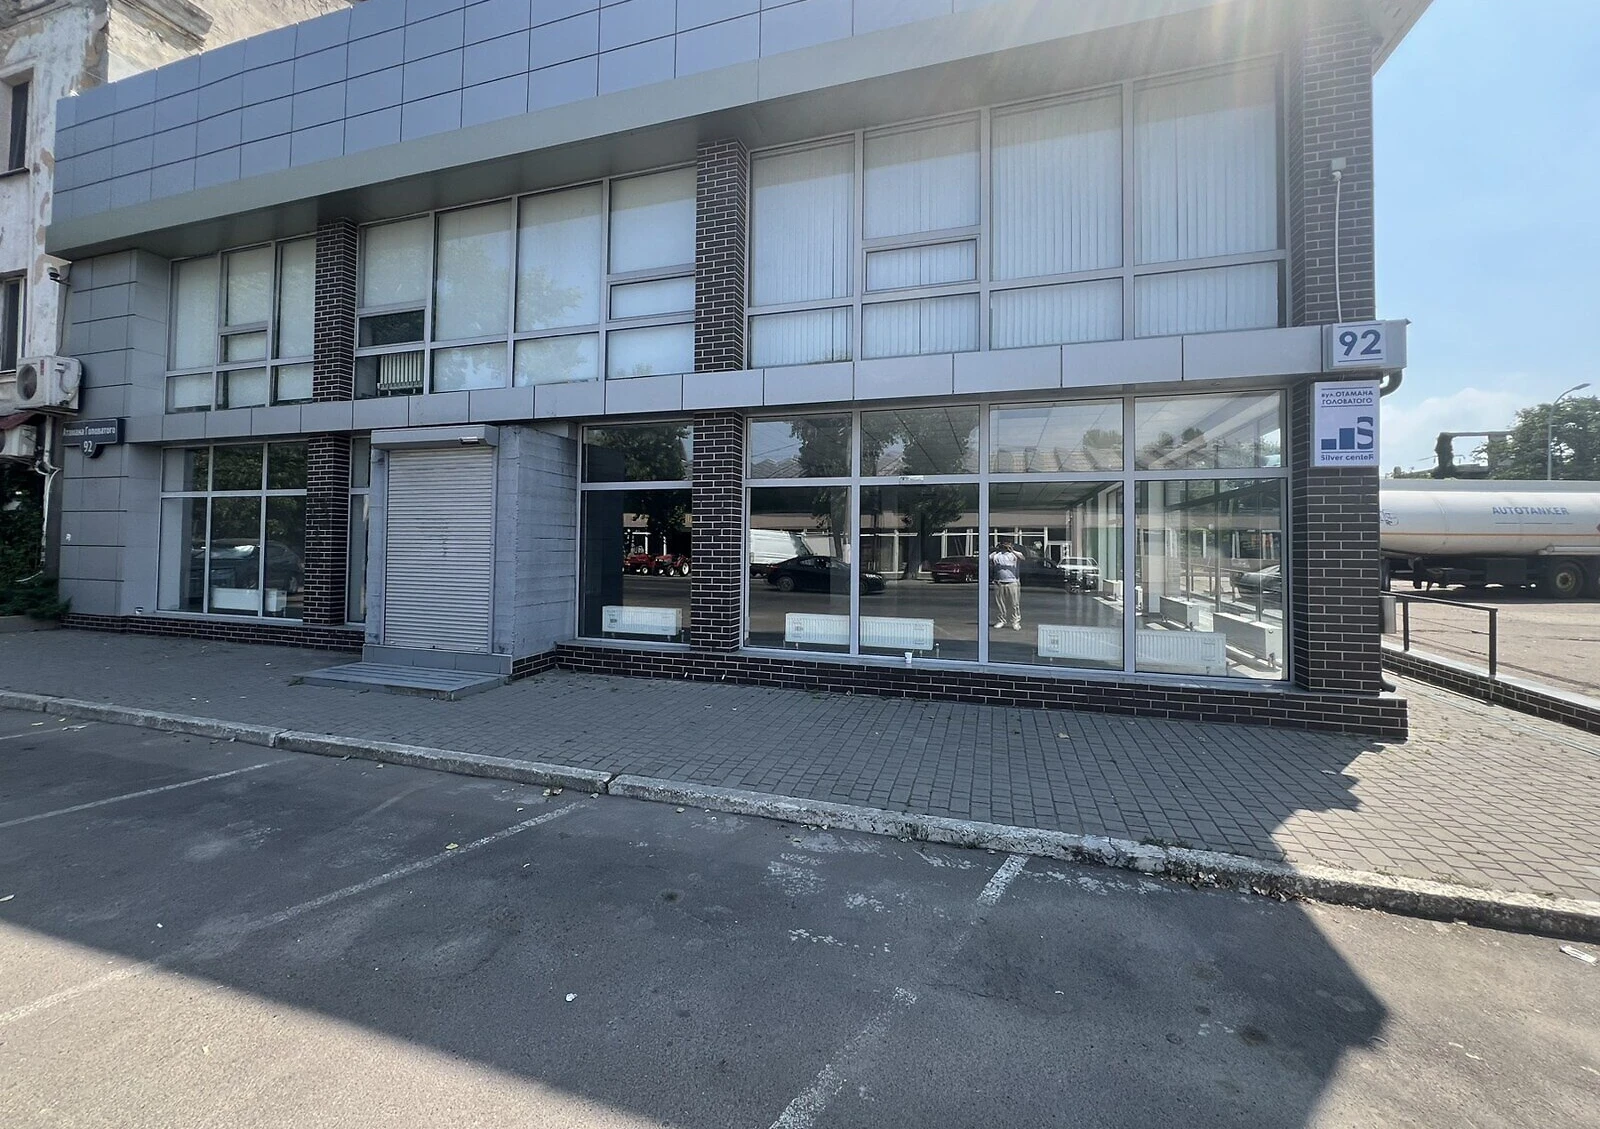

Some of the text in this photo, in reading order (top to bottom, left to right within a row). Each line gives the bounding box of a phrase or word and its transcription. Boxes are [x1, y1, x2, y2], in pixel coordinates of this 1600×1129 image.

[1339, 329, 1381, 356] 92
[1322, 397, 1373, 405] ГОЛОВАТОГО
[1357, 416, 1374, 450] S
[83, 440, 93, 453] 92
[1492, 506, 1570, 516] AUTOTANKER
